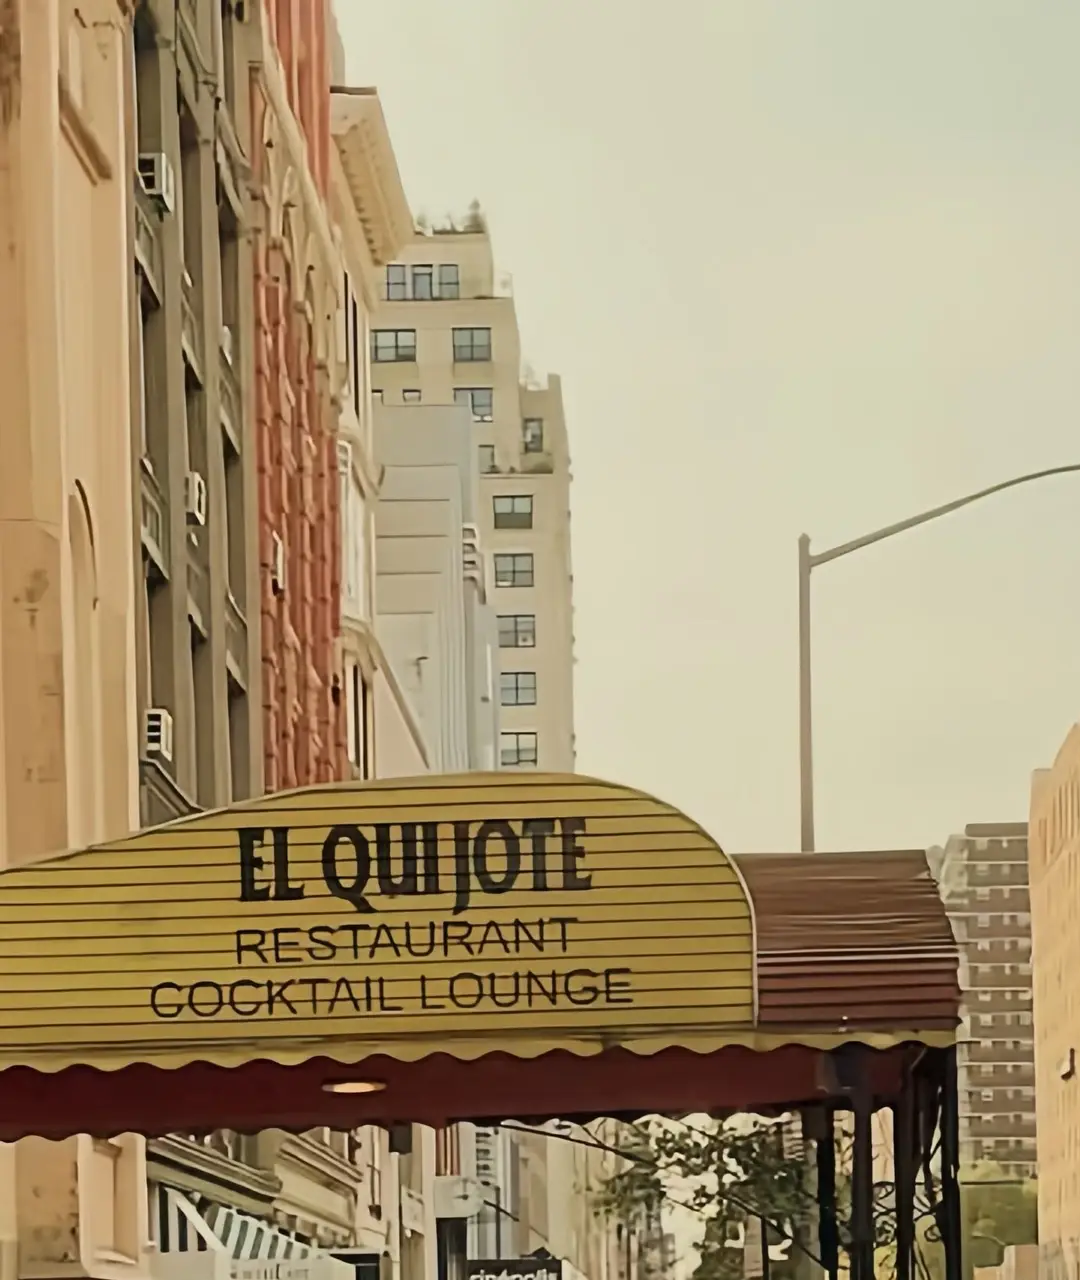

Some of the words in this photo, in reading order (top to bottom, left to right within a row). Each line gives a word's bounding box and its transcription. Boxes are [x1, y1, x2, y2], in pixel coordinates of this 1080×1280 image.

[238, 827, 305, 902] EL
[321, 817, 593, 915] QUIJOTE
[235, 917, 579, 965] RESTAURANT
[150, 976, 404, 1019] COCKTAIL
[420, 968, 635, 1010] LOUNGE
